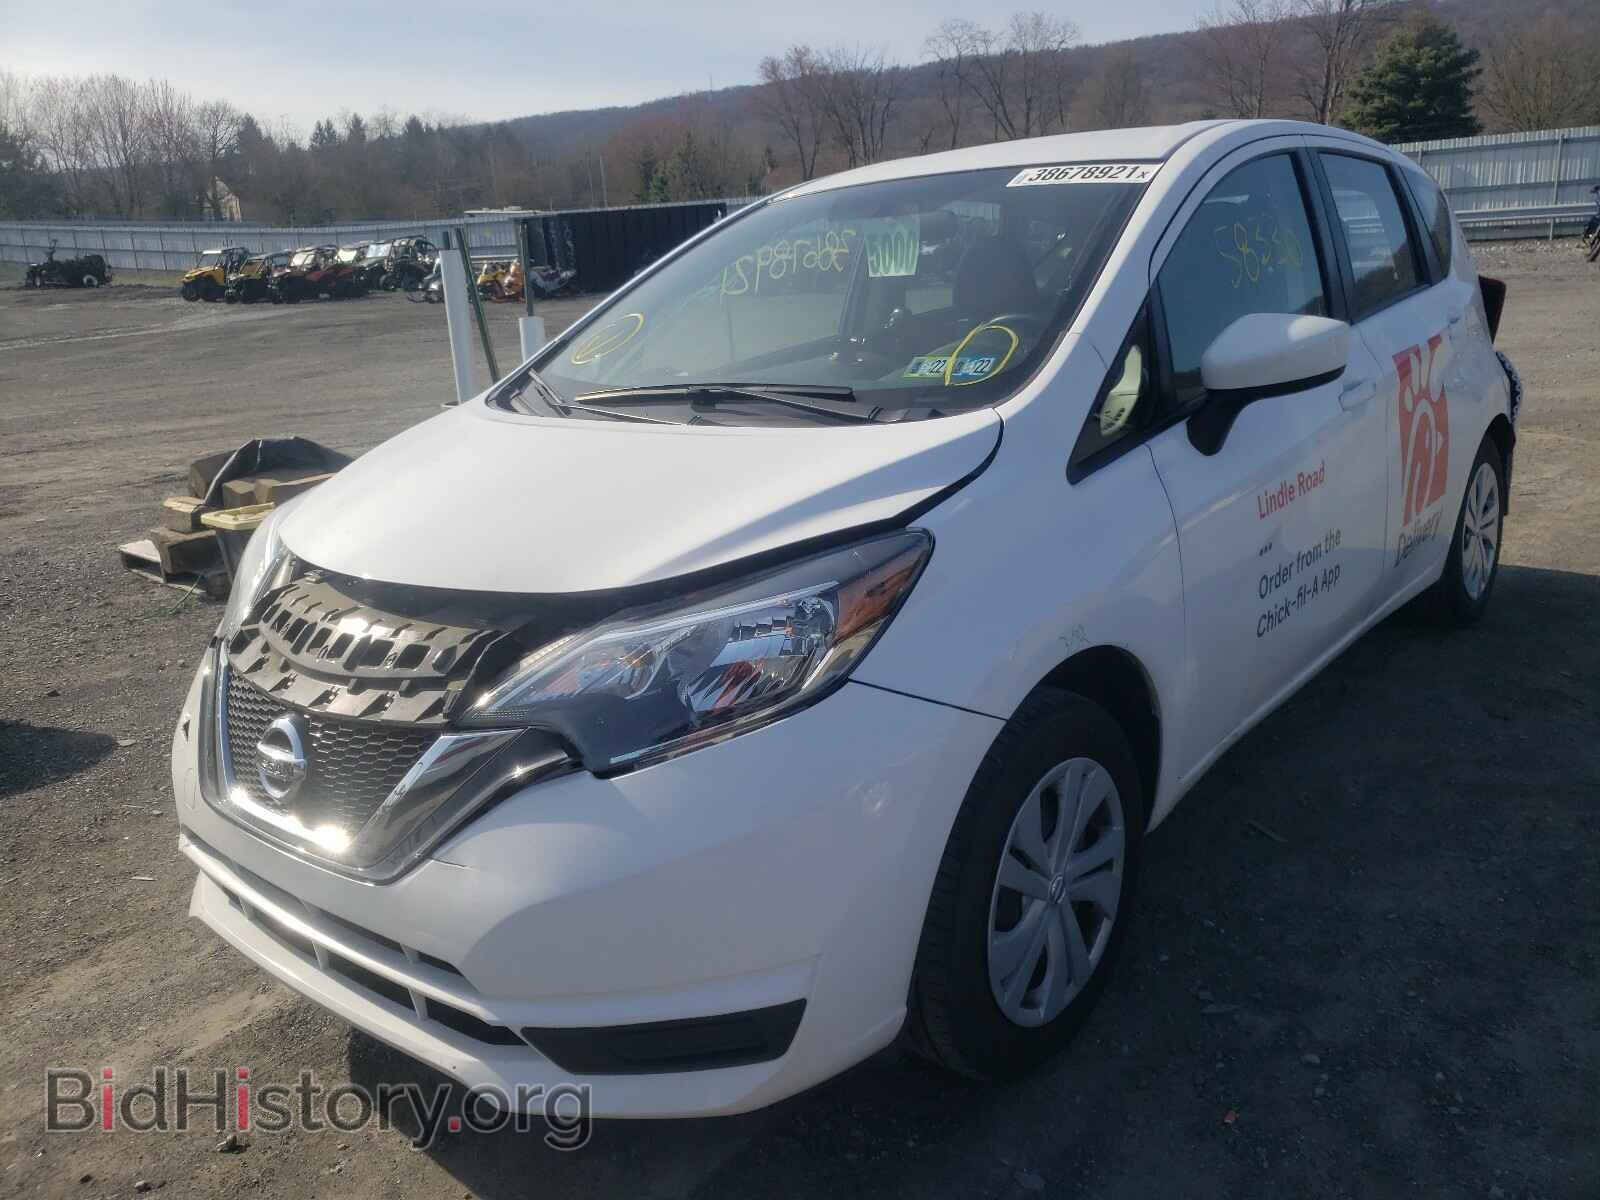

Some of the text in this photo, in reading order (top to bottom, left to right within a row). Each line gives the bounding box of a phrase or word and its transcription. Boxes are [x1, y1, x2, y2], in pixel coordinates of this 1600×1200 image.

[929, 360, 946, 374] 22
[974, 359, 991, 374] 22
[1257, 459, 1325, 520] Lindle Road
[1258, 528, 1341, 600] Order from the
[1320, 564, 1341, 592] App
